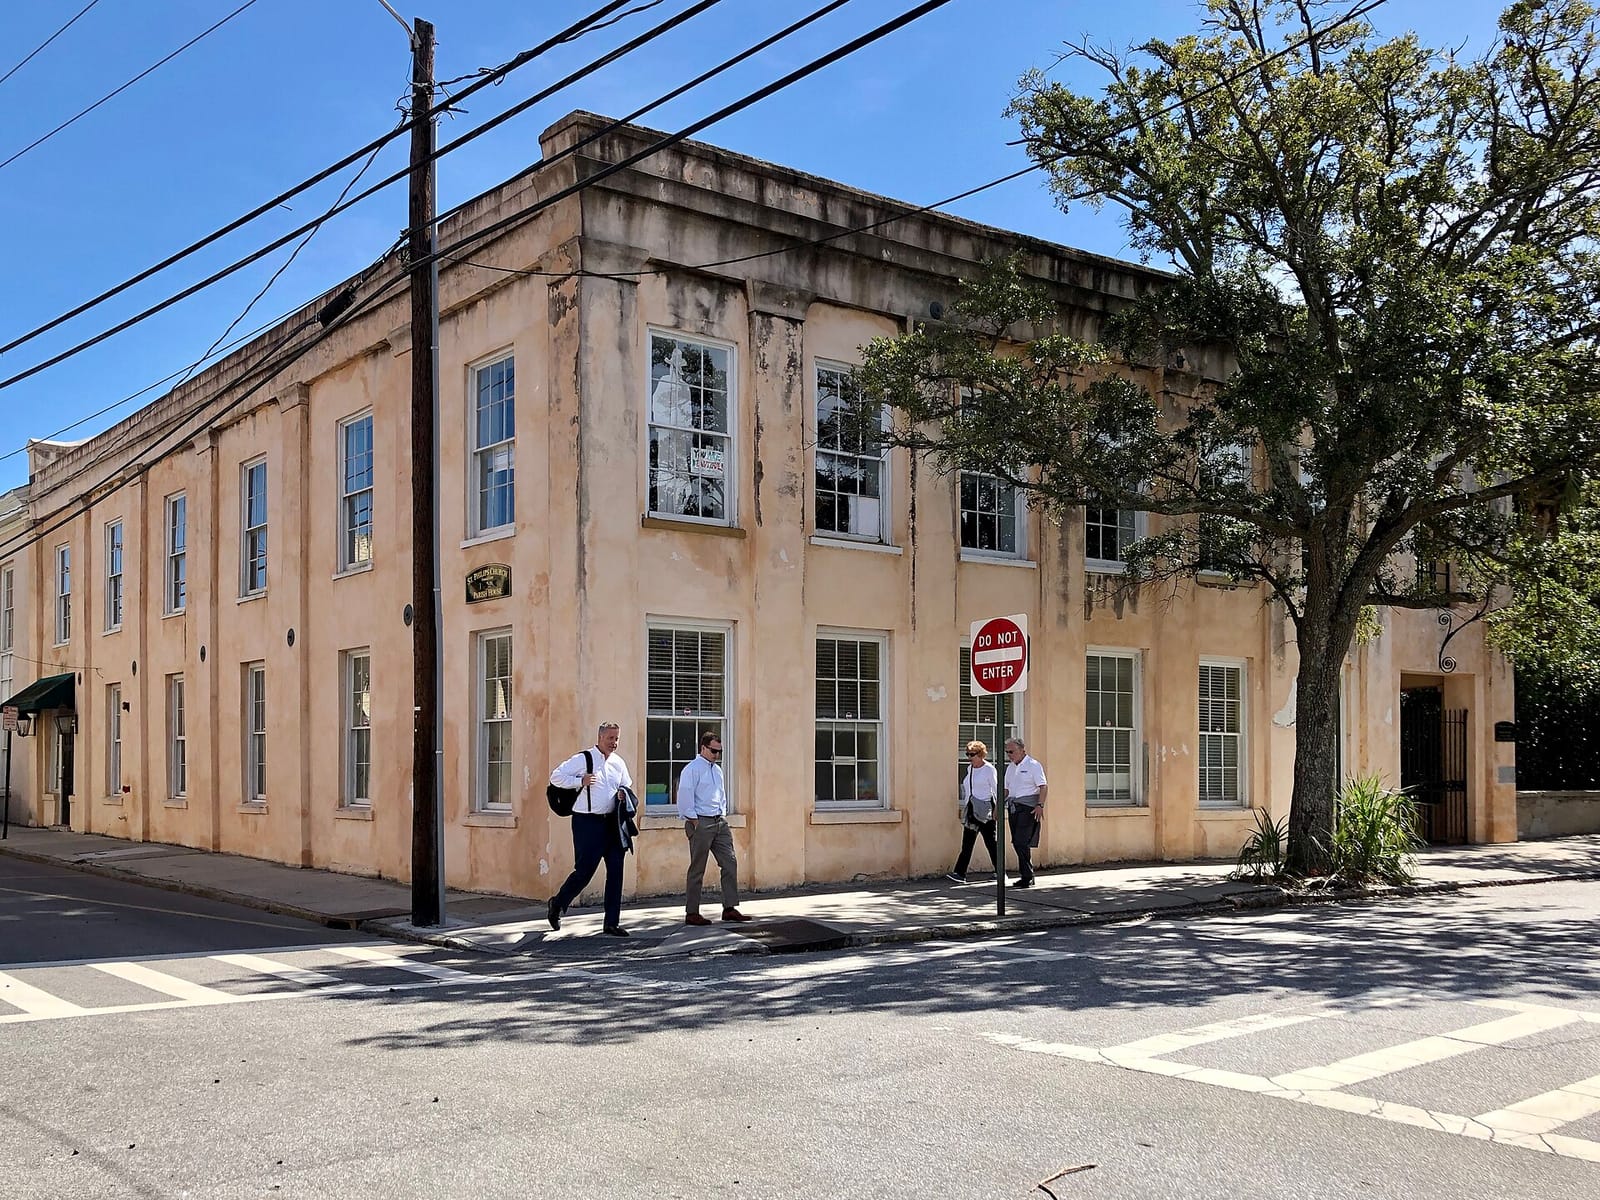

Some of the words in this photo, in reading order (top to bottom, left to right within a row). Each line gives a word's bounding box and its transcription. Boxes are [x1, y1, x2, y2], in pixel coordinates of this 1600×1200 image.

[978, 635, 992, 648] DO
[997, 630, 1018, 645] NOT
[982, 665, 1014, 680] ENTER
